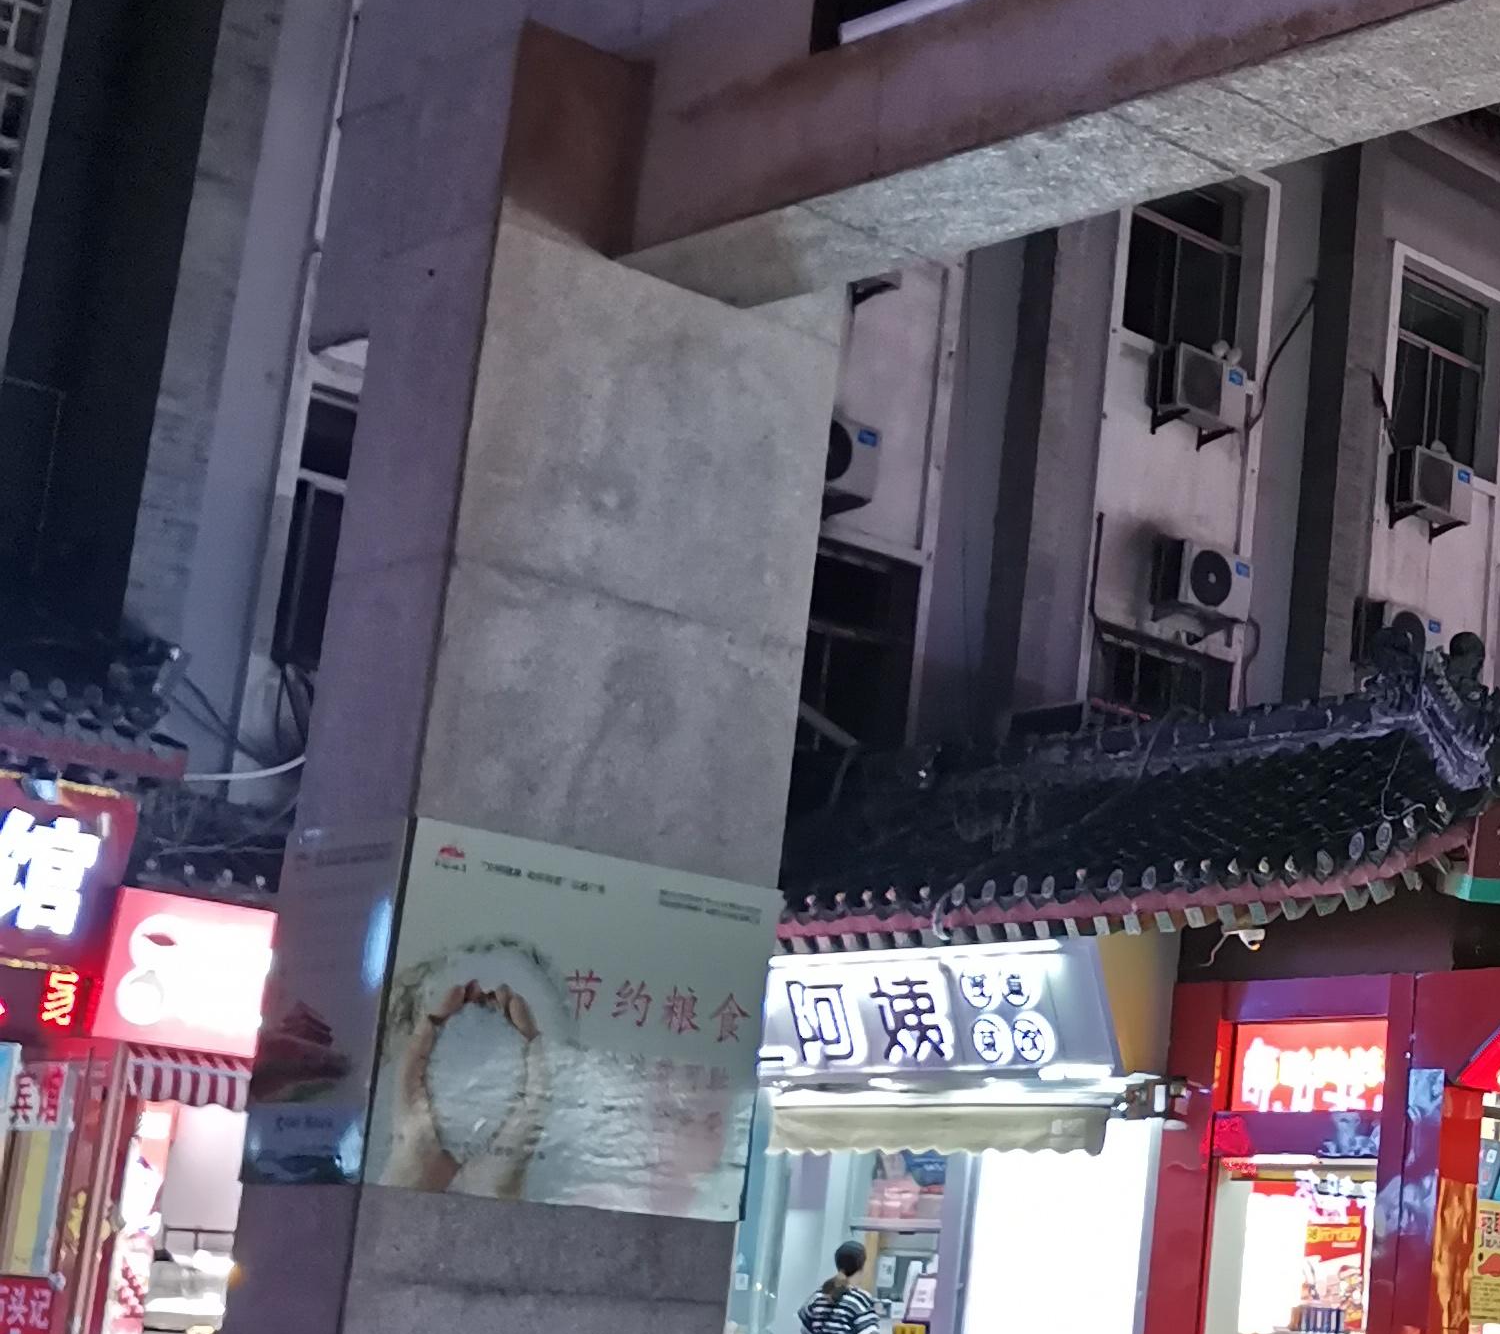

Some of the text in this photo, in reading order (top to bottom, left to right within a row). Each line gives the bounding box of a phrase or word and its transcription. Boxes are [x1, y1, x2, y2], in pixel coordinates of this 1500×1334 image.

[566, 969, 751, 1044] 节约粮食
[760, 976, 946, 1063] 阿姨
